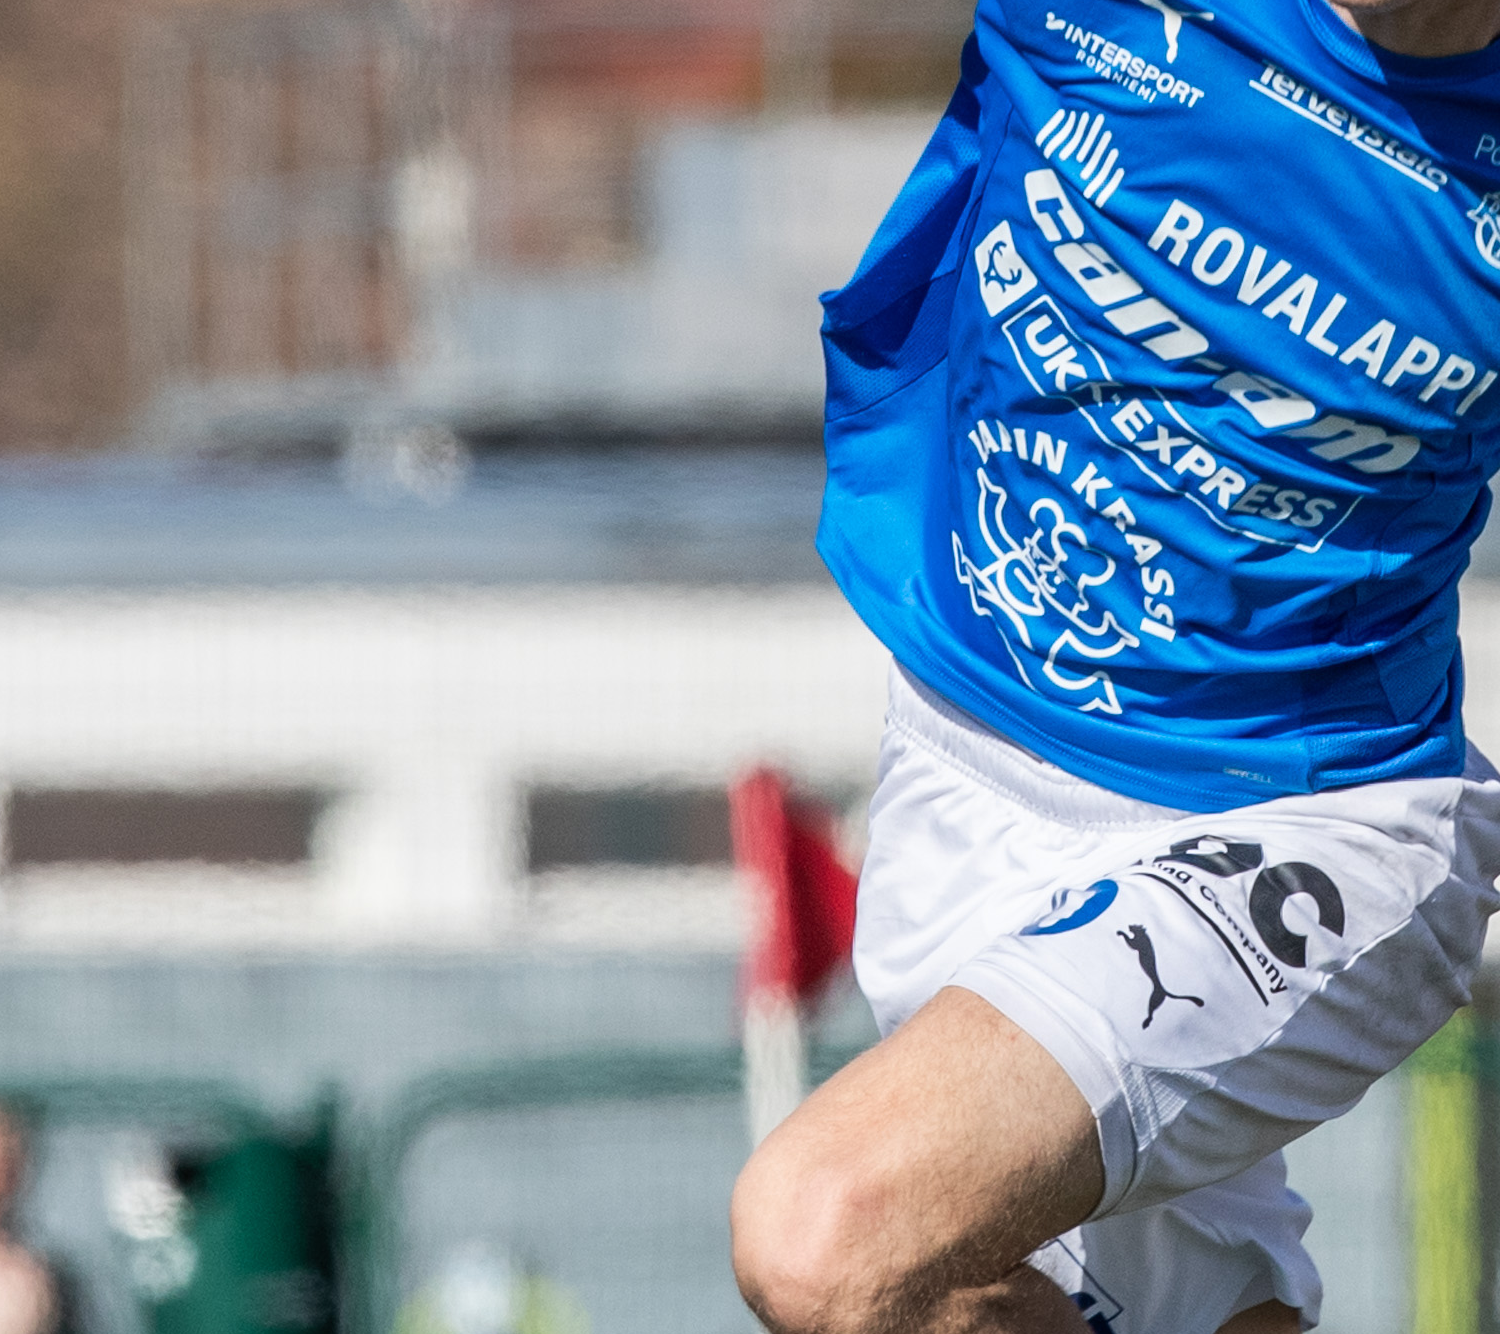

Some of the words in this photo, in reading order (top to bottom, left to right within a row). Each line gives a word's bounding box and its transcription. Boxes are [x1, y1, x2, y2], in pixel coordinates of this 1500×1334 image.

[1064, 23, 1205, 108] INTERSPORT
[1075, 48, 1158, 104] ROVANIEMI
[1146, 198, 1499, 418] ROVALAPPI
[1070, 461, 1177, 643] KRASSI
[1199, 884, 1289, 995] Company
